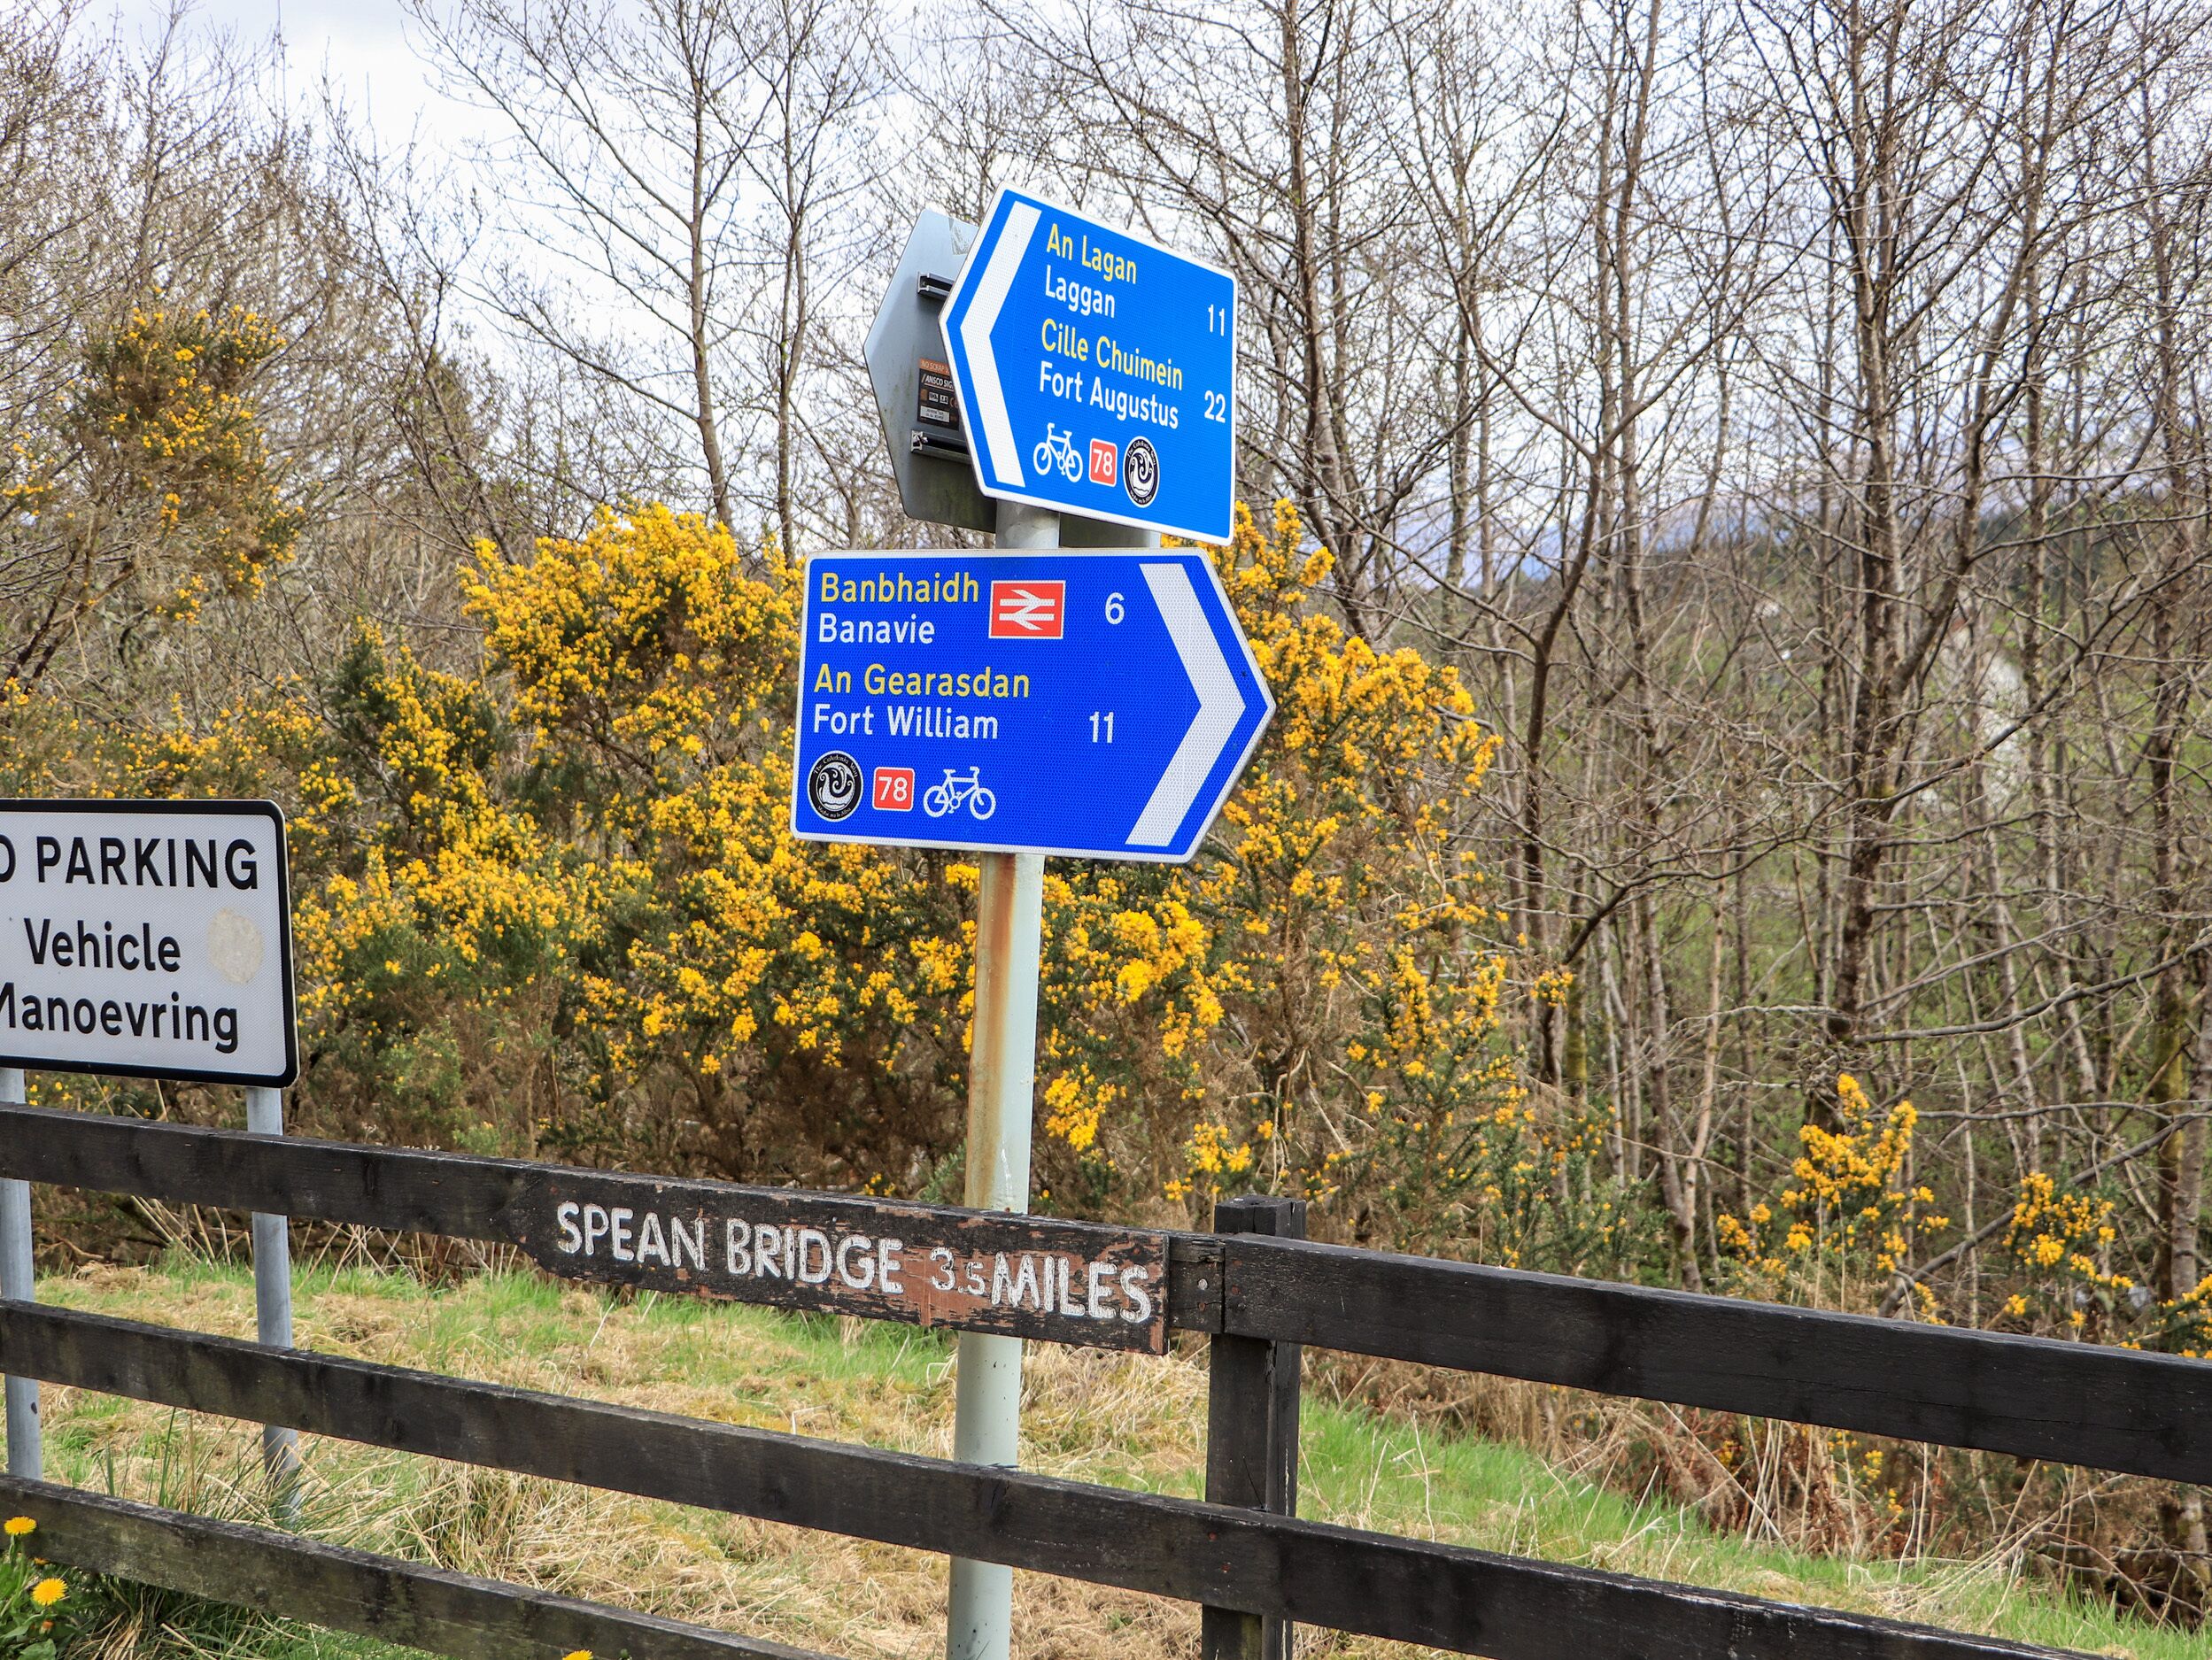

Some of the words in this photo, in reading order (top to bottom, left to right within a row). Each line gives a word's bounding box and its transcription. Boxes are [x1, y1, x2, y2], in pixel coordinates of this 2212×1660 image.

[1047, 223, 1073, 261] An
[1081, 235, 1137, 284] Lagan
[1046, 266, 1115, 319] Laggan
[1208, 305, 1226, 336] 11
[1041, 319, 1088, 361] Cille
[1097, 336, 1183, 390] Chuimein
[1040, 361, 1082, 403] Fort
[1090, 375, 1179, 429] Augustus
[1204, 391, 1226, 423] 22
[1094, 448, 1113, 477] 78
[821, 571, 978, 603] Banbhaidh
[1105, 592, 1125, 625] 6
[818, 614, 934, 644] Banavie
[815, 664, 851, 694] An
[864, 664, 1030, 698] Gearasdan
[814, 705, 873, 735] Fort
[887, 705, 998, 739] William
[1090, 712, 1113, 744] 11
[878, 776, 908, 802] 78
[36, 836, 258, 890] PARKING
[24, 918, 181, 972] Vehicle
[557, 1200, 705, 1270] SPEAN
[726, 1217, 903, 1294] BRIDGE
[931, 1247, 985, 1297] 3.5
[990, 1251, 1152, 1324] MILES
